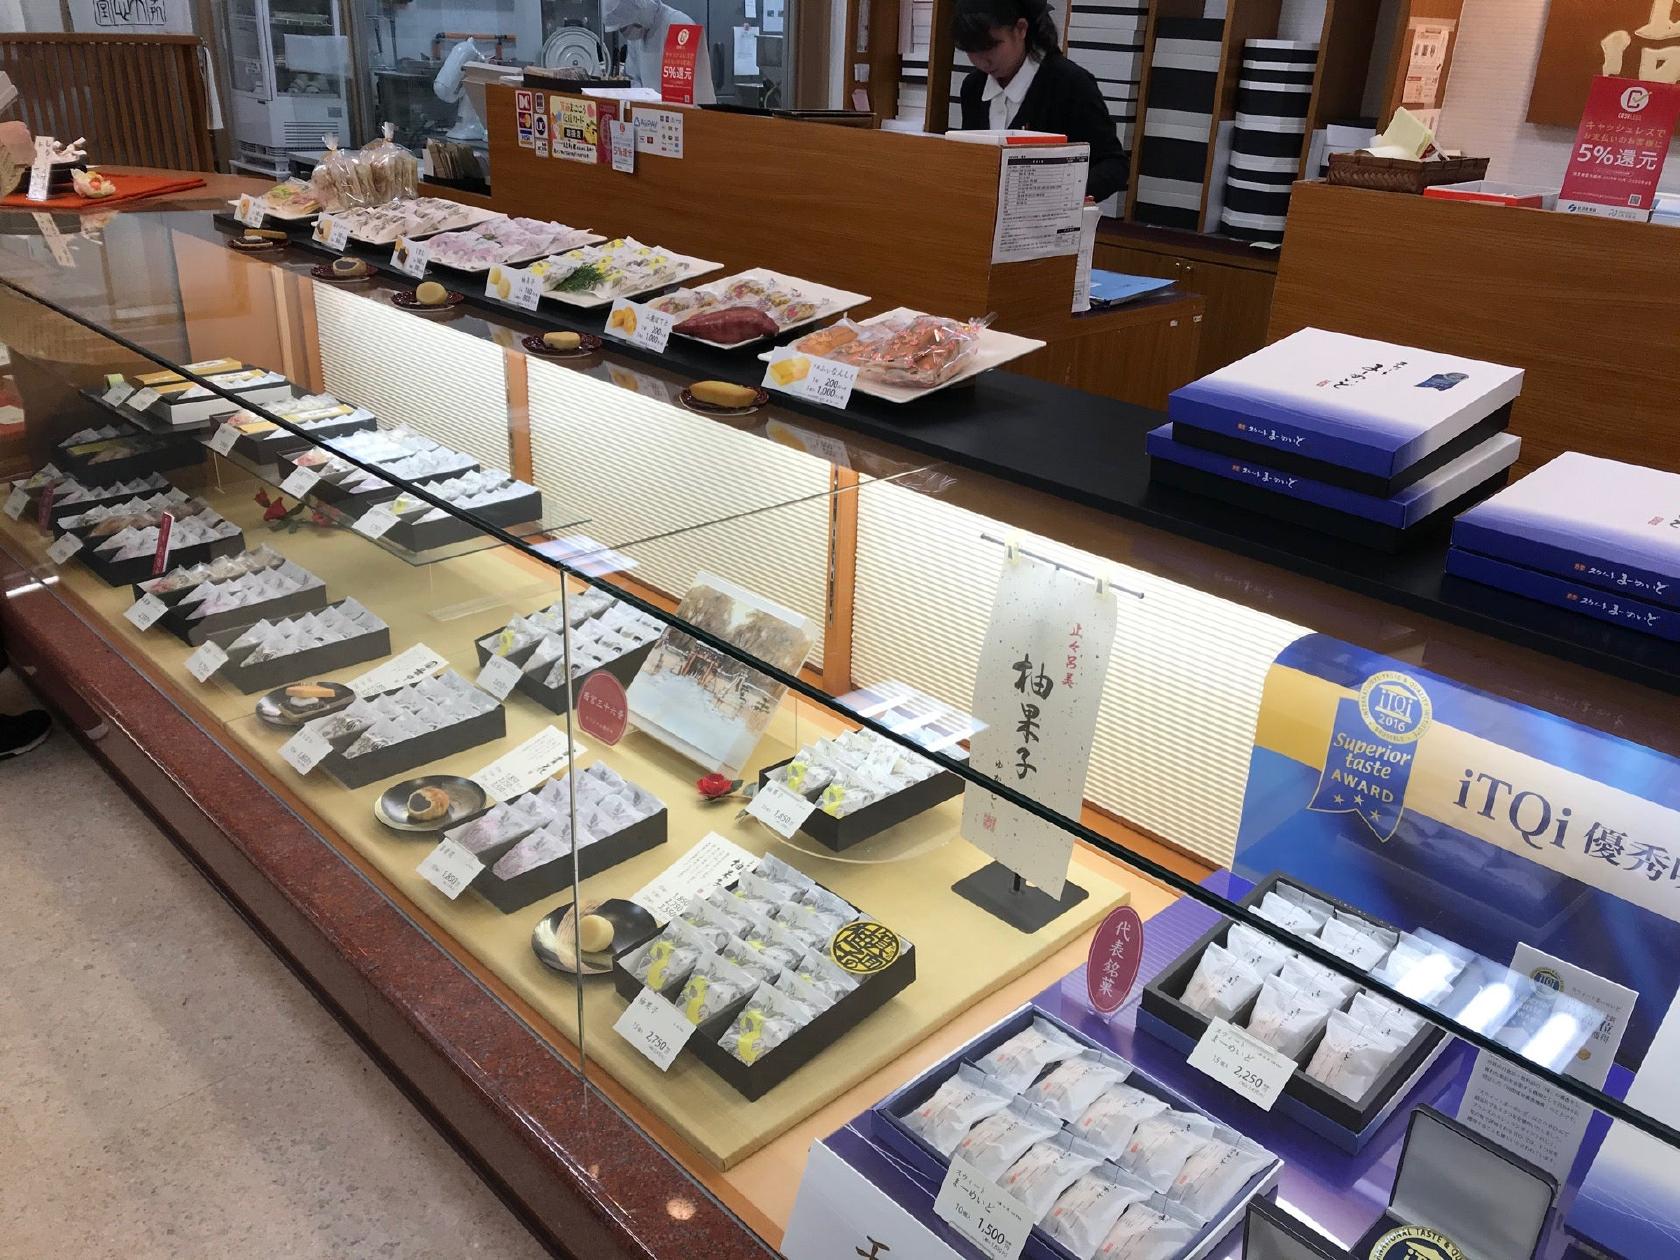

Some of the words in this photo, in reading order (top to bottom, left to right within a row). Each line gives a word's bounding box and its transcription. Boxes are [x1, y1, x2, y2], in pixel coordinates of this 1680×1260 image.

[1585, 121, 1666, 138] キャッシュレスで
[1577, 143, 1658, 170] 5%還元
[825, 377, 839, 388] 200
[1616, 572, 1669, 595] まーめいど
[1608, 604, 1661, 627] まーめいど
[1011, 653, 1054, 780] 柚果子
[1379, 689, 1413, 720] iTQi
[1378, 713, 1406, 732] 2016
[1333, 732, 1412, 766] Superior
[1345, 753, 1392, 779] taste
[1331, 769, 1394, 803] AWARD
[1452, 768, 1572, 850] iTQi
[1099, 920, 1131, 998] 代表銘菓
[646, 1031, 667, 1051] 2,750
[1212, 1035, 1255, 1062] まーめいど
[1233, 1066, 1263, 1088] 2,250
[956, 1170, 985, 1194] スウィート
[953, 1178, 995, 1213] まーめいど
[978, 1217, 1005, 1244] 1,500
[1416, 1228, 1442, 1243] TASTE
